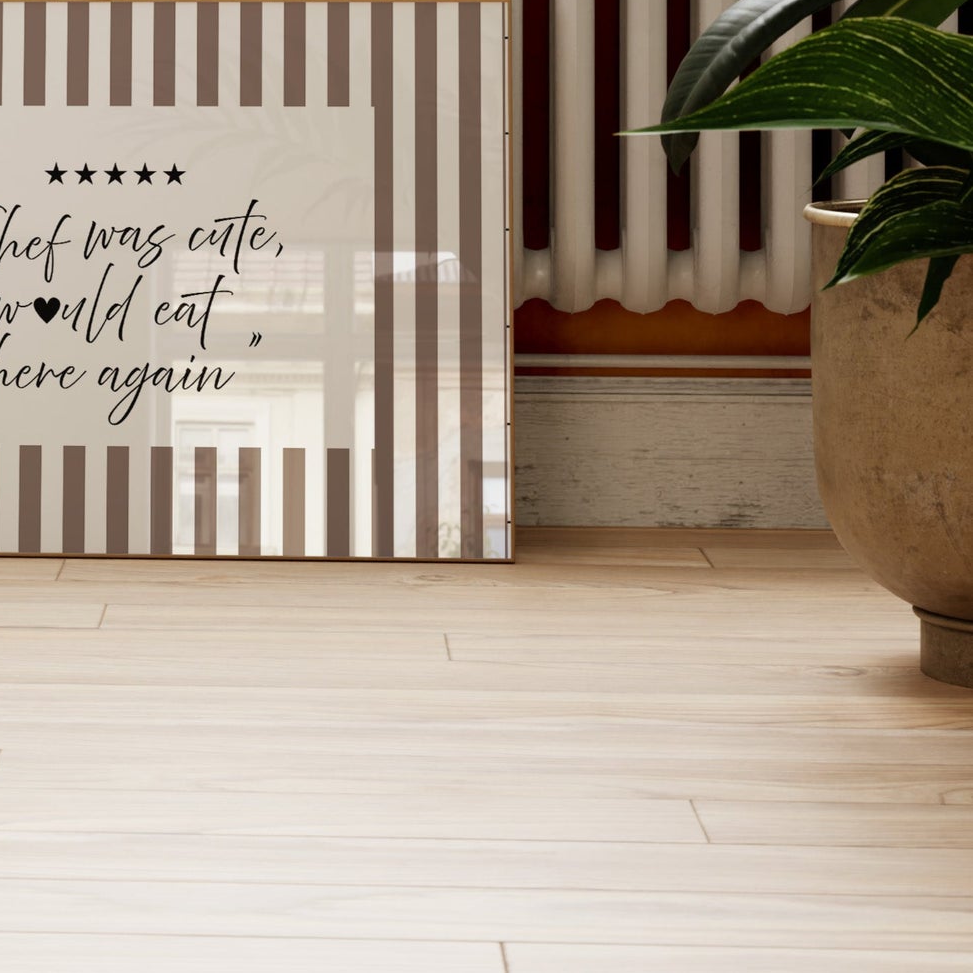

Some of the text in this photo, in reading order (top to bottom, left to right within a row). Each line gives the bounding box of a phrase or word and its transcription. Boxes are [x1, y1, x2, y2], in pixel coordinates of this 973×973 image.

[84, 221, 175, 268] was
[188, 199, 283, 274] cute,
[154, 275, 233, 350] eat
